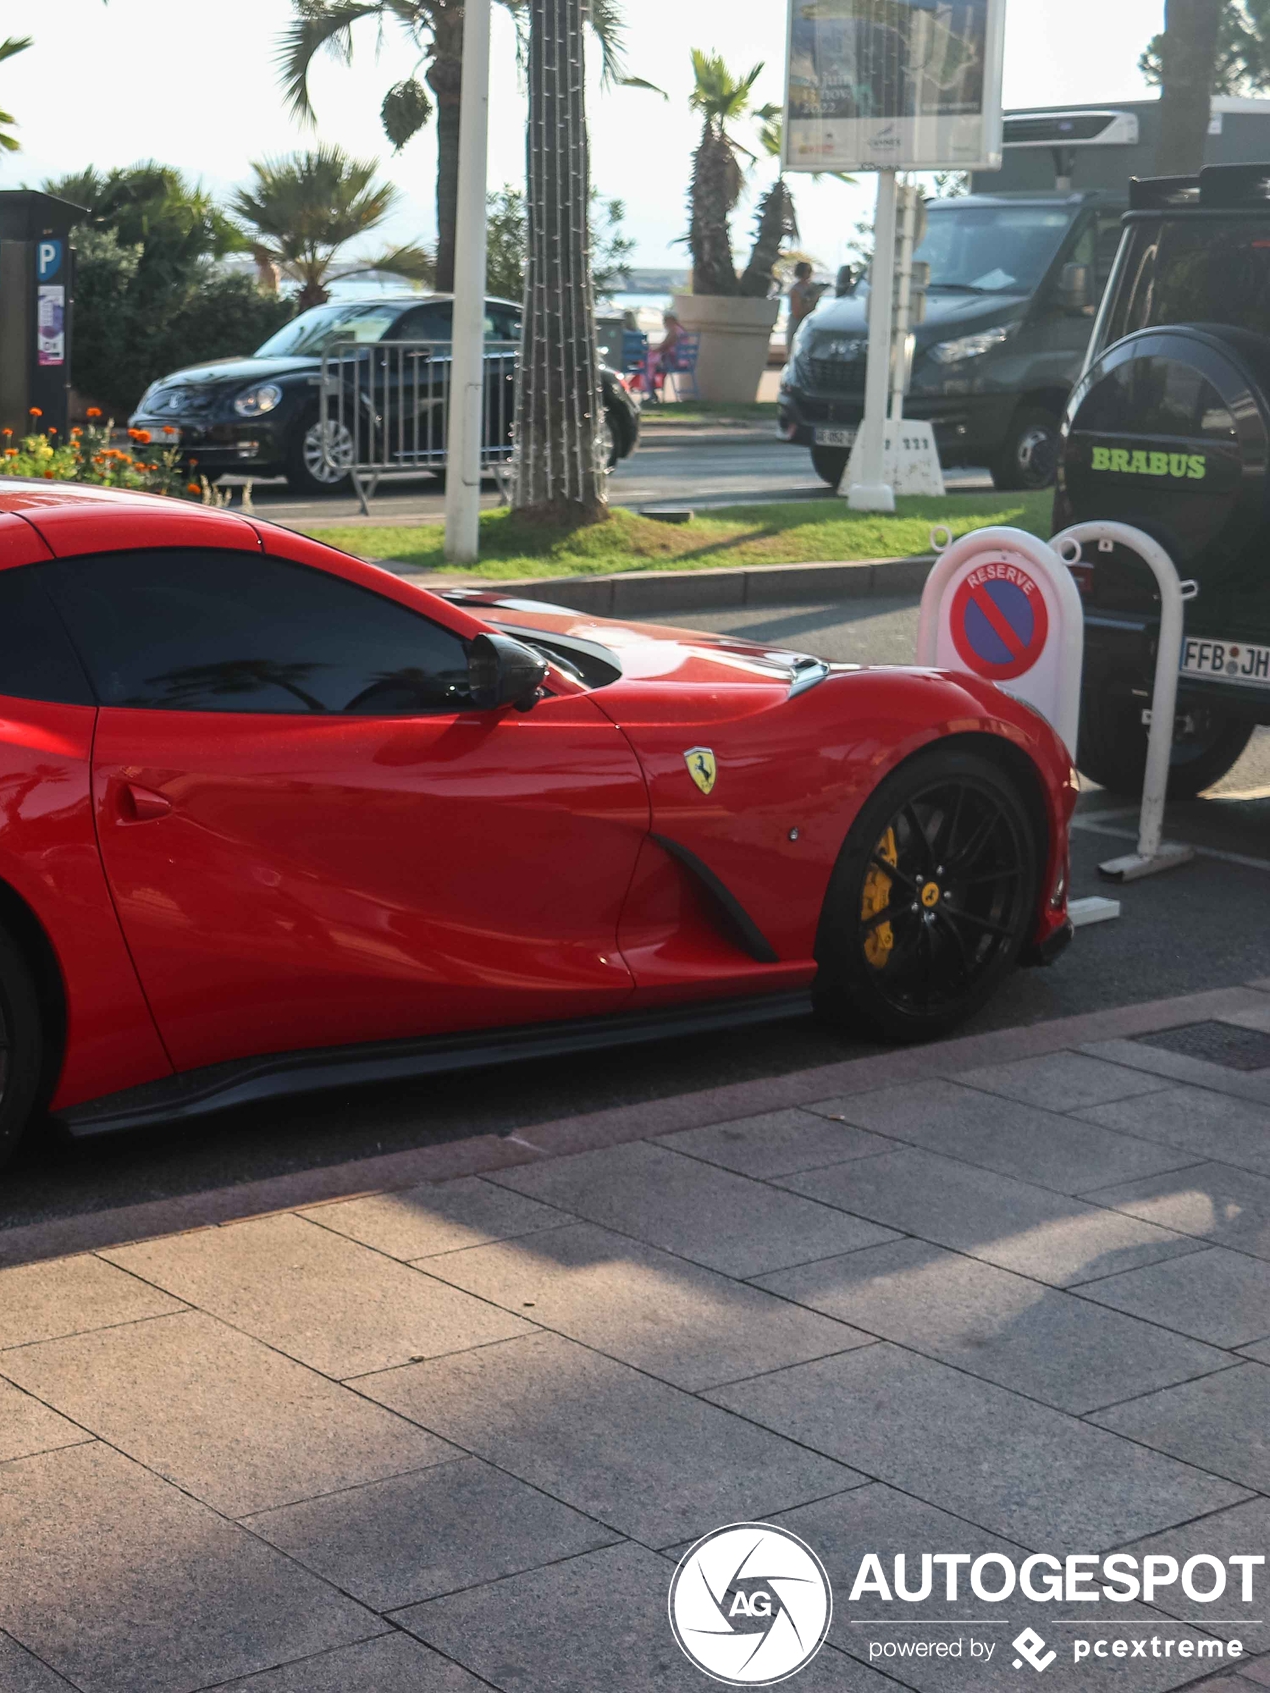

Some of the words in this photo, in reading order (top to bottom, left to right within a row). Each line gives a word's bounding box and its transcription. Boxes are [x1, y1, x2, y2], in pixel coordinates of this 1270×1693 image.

[39, 244, 56, 274] P
[1091, 446, 1206, 480] BRABUS
[967, 564, 1035, 595] RESERVE
[1184, 641, 1225, 671] FFB
[1241, 648, 1270, 678] JH
